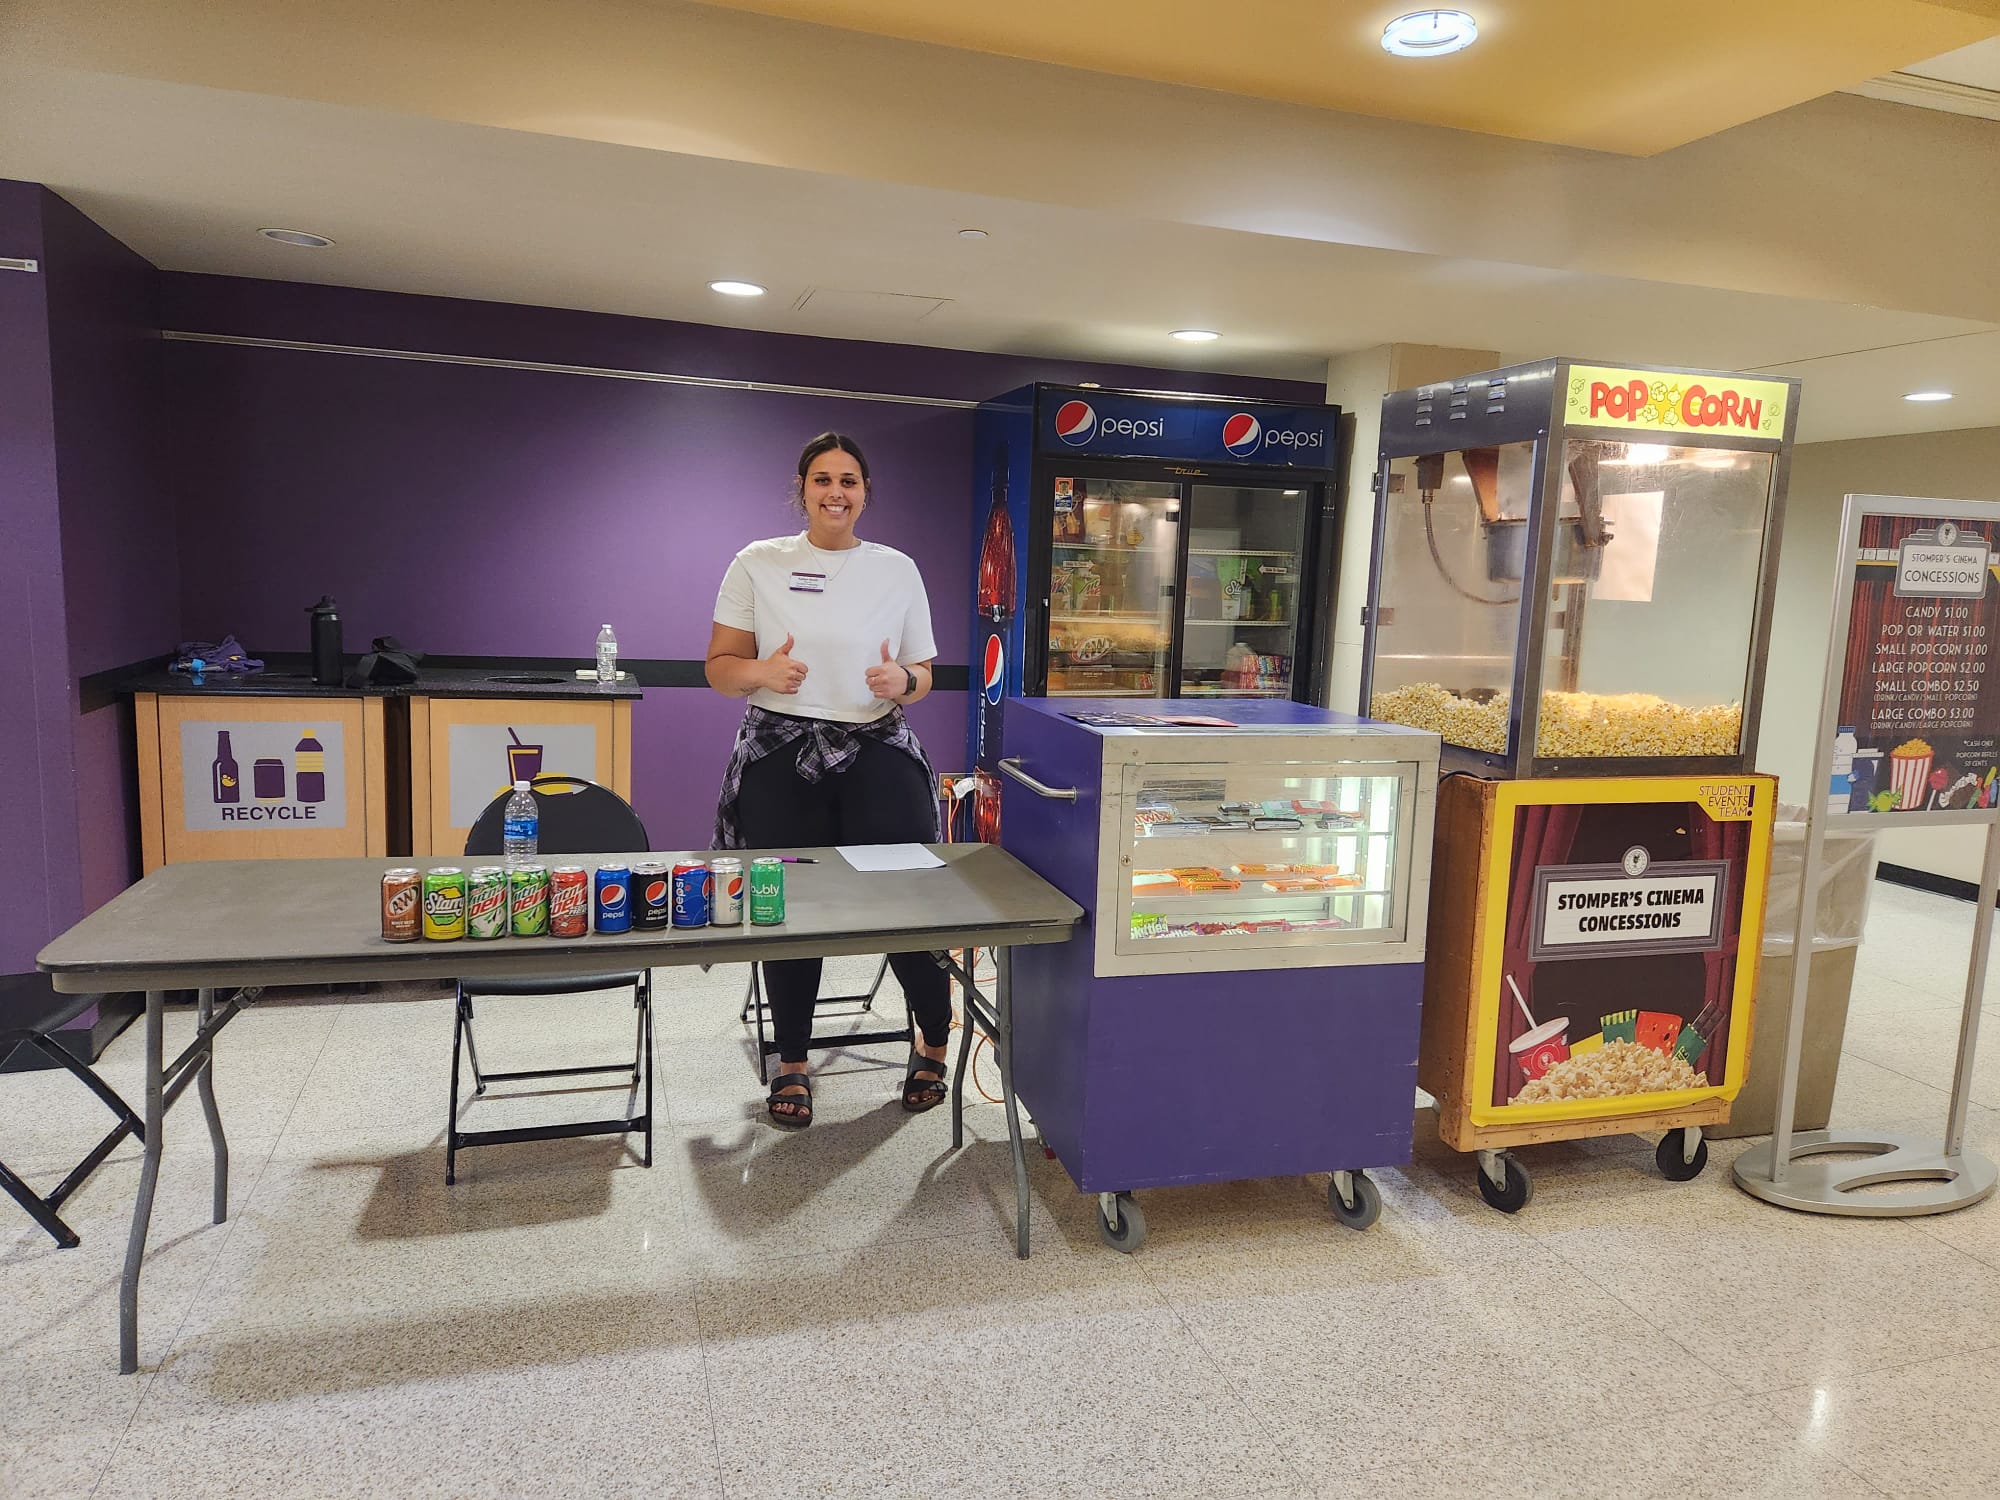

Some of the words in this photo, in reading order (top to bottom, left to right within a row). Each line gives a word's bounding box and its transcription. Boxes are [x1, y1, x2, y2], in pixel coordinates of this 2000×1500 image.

[1589, 379, 1649, 422] POP
[1681, 384, 1763, 431] CORN
[1101, 418, 1164, 439] pepsi
[1264, 429, 1324, 450] pepsi
[1911, 553, 1951, 564] STOMPER'S
[1953, 555, 1978, 564] CINEMA
[1904, 569, 1981, 584] CONCESSIONS
[1905, 606, 1941, 618] CANDY
[1944, 607, 1969, 618] $1.00
[1881, 624, 1903, 636] POP
[1907, 624, 1923, 636] OR
[1927, 625, 1959, 637] WATER
[1962, 626, 1986, 637] $1.00
[1875, 643, 1907, 655] SMALL
[1910, 643, 1961, 655] POPCORN
[1964, 644, 1988, 655] $1.00
[1872, 661, 1905, 673] LARGE
[1907, 662, 1957, 673] POPCORN
[1960, 662, 1986, 673] $2.00
[1875, 680, 1907, 692] SMALL
[1911, 680, 1950, 691] COMBO
[1953, 680, 1980, 691] $2.50
[1944, 693, 1978, 701] POPCORN)
[1871, 708, 1905, 720] LARGE
[1907, 708, 1946, 719] COMBO
[1949, 707, 1975, 719] $3.00
[1940, 721, 1974, 729] POPCORN)
[1699, 785, 1749, 796] STUDENT
[1708, 796, 1748, 807] EVENTS
[222, 806, 317, 821] RECYCLE
[675, 878, 686, 914] pepsi
[751, 883, 780, 897] bubly
[1557, 890, 1643, 911] STOMPER'S
[1646, 888, 1705, 906] CINEMA
[602, 910, 625, 920] pepsi
[647, 908, 667, 917] pepsi
[1578, 912, 1682, 933] CONCESSIONS
